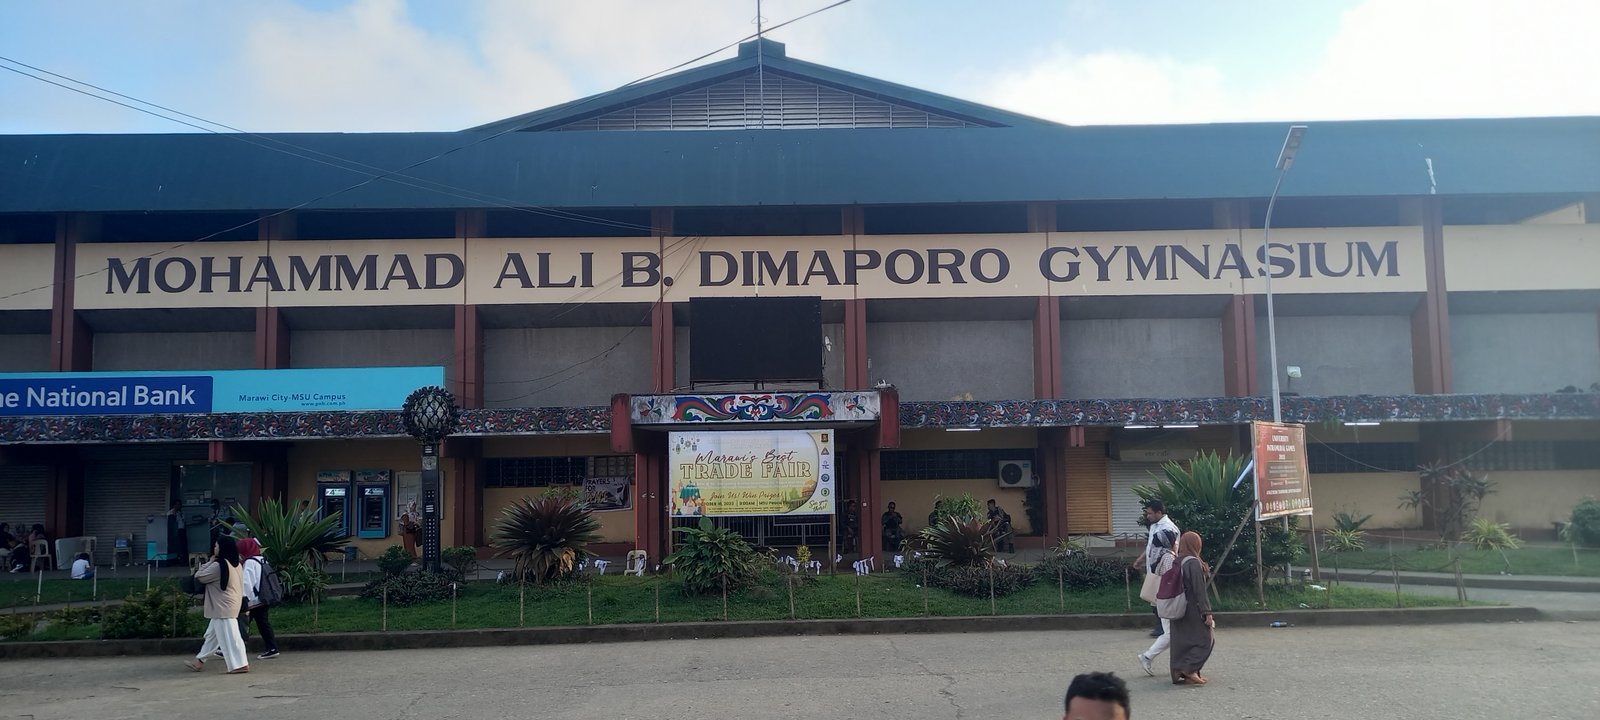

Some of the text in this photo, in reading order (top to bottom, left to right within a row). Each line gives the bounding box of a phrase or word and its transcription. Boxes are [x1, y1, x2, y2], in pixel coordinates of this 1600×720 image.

[106, 240, 1400, 295] MOHAMMAD ALI B. DIMAPORO GYMNASIUM
[26, 385, 127, 408] National
[133, 384, 196, 406] Bank
[239, 392, 346, 403] Marawi City-MSU Campus
[695, 449, 799, 465] Marawi's Best
[680, 461, 812, 480] TRADE FAIR
